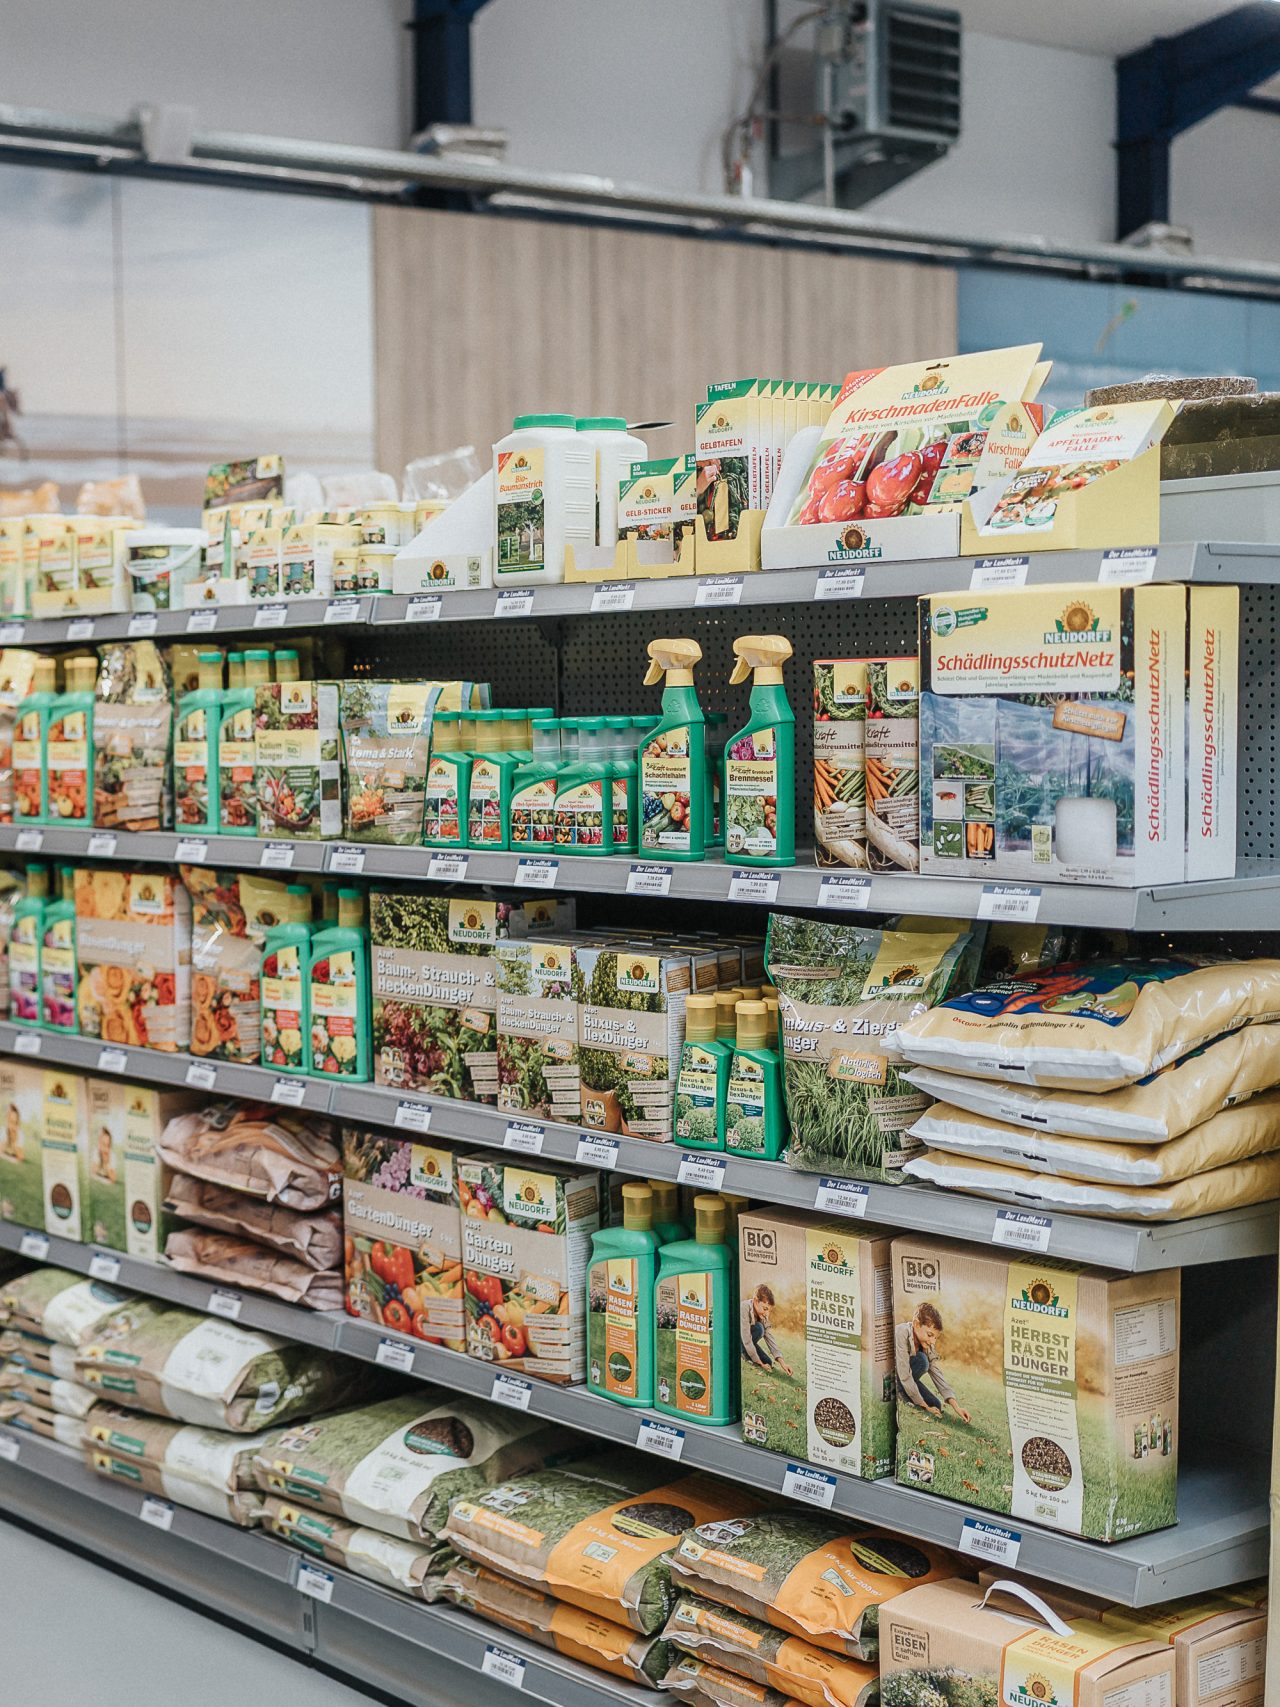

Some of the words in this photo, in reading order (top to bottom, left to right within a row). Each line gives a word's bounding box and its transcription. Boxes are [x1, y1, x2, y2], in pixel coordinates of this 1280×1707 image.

[714, 382, 737, 392] TAFELN
[901, 387, 949, 400] NEUDORFF
[844, 391, 1000, 424] KirschmadenFalle
[700, 438, 743, 450] GELBTAFELN
[1048, 435, 1126, 448] APFELMADEN-
[1065, 444, 1099, 452] FALLE
[515, 475, 528, 484] Bio-
[499, 480, 543, 493] Baumanstrich
[625, 506, 672, 518] GELB-STICKER
[827, 548, 882, 561] NEUDORFF
[1109, 550, 1119, 558] Der
[1120, 548, 1153, 558] LandMarkt
[982, 559, 993, 567] Der
[994, 558, 1023, 567] LandMarkt
[824, 570, 834, 578] Der
[834, 568, 861, 577] LandMarkt
[1044, 631, 1111, 644] NEUDORFF
[936, 651, 1115, 675] SchädlingsschutzNetz
[1148, 629, 1163, 842] SchädlingsschutzNetz
[1201, 628, 1217, 838] SchädlingsschutzNetz
[386, 747, 414, 759] Stark
[644, 771, 687, 780] Schachtelhalm
[729, 774, 774, 783] Brennnessel
[645, 866, 668, 875] LandMarkt
[739, 871, 748, 879] Der
[749, 872, 774, 880] LandMarkt
[838, 877, 866, 886] LandMarkt
[994, 886, 1003, 894] Der
[1003, 887, 1031, 896] LandMarkt
[452, 929, 491, 940] NEUDORFF
[377, 959, 420, 977] Baum-,
[421, 965, 481, 986] Strauch-
[483, 971, 495, 987] &
[534, 968, 568, 978] NEUDORFF
[621, 978, 656, 988] NEUDORFF
[377, 977, 474, 1004] HeckenDünger
[500, 1005, 528, 1019] Baum-,
[529, 1008, 566, 1023] Strauch-
[566, 1014, 575, 1024] &
[1081, 999, 1093, 1009] 5
[1093, 1003, 1118, 1019] kg
[500, 1015, 561, 1034] HeckenDünger
[584, 1015, 624, 1031] Buxus-
[625, 1019, 637, 1033] &
[832, 1018, 848, 1034] &
[986, 1021, 1019, 1029] Animalin
[1074, 1022, 1085, 1030] kg
[584, 1030, 649, 1050] IlexDünger
[839, 1055, 880, 1070] Natürlich
[837, 1065, 882, 1080] BIOlogisch
[680, 1076, 699, 1084] Buxus-
[679, 1082, 714, 1092] IlexDünger
[729, 1085, 749, 1093] Buxus-
[729, 1091, 762, 1101] IlexDünger
[520, 1123, 541, 1133] LandMarkt
[594, 1136, 615, 1146] LandMarkt
[687, 1154, 696, 1162] Der
[696, 1156, 720, 1166] LandMarkt
[414, 1174, 449, 1188] NEUDORFF
[827, 1180, 836, 1188] Der
[836, 1182, 863, 1193] LandMarkt
[508, 1200, 551, 1216] NEUDORFF
[347, 1199, 433, 1238] GartenDünger
[1005, 1211, 1016, 1220] Der
[1016, 1213, 1048, 1227] LandMarkt
[464, 1230, 513, 1256] Garten
[747, 1231, 773, 1249] BIO
[466, 1248, 515, 1273] Dünger
[747, 1253, 774, 1261] ROHSTOFFE
[810, 1261, 855, 1277] NEUDORFF
[906, 1261, 936, 1280] BIO
[906, 1282, 937, 1292] ROHSTOFFE
[608, 1294, 633, 1308] RASEN
[810, 1287, 855, 1306] HERBST
[608, 1304, 633, 1317] DÜNGER
[810, 1299, 855, 1319] RASEN
[1012, 1299, 1068, 1318] NEUDORFF
[679, 1311, 707, 1324] RASEN
[810, 1312, 855, 1331] DÜNGER
[679, 1320, 707, 1333] DÜNGER
[1010, 1325, 1070, 1348] HERBST
[1011, 1339, 1069, 1364] RASEN
[1011, 1355, 1069, 1377] DÜNGER
[657, 1423, 677, 1436] LandMarkt
[796, 1467, 805, 1475] Der
[805, 1469, 828, 1482] LandMarkt
[1030, 1491, 1038, 1499] kg
[975, 1522, 984, 1530] Der
[984, 1525, 1012, 1538] LandMarkt
[894, 1634, 927, 1652] EISEN
[1039, 1635, 1089, 1655] RASEN
[493, 1647, 501, 1656] Der
[501, 1650, 522, 1664] LandMarkt
[900, 1646, 925, 1659] saftiges
[1032, 1640, 1081, 1661] DÜNGER
